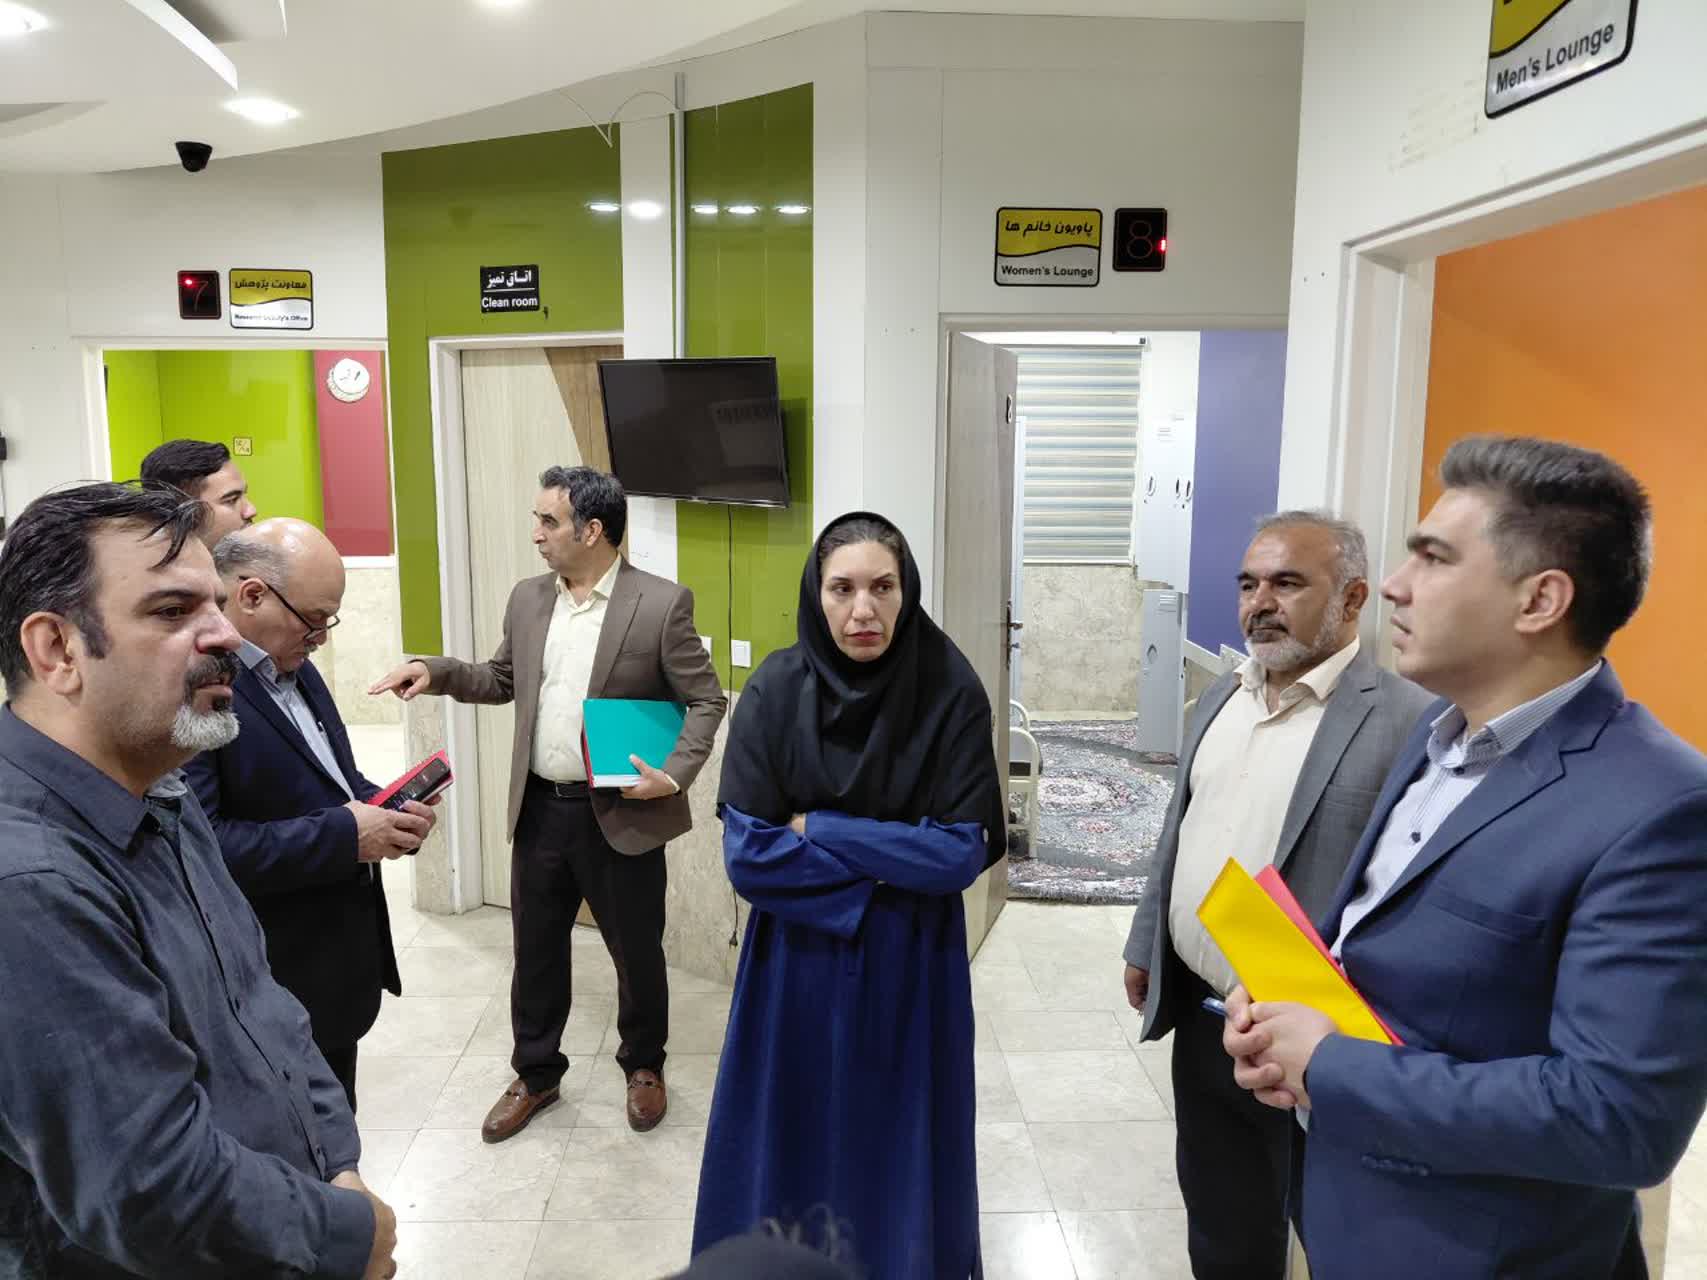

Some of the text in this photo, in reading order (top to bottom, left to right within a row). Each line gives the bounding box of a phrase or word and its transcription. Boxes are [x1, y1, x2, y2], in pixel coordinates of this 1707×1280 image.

[1496, 23, 1615, 94] Men's Lounge
[1005, 220, 1094, 238] پاویون خانم ها
[1126, 219, 1154, 260] 8
[486, 269, 532, 289] اتاق تمیز
[1001, 265, 1094, 278] Women's Lounge
[234, 278, 307, 291] معاونت پژوهش
[481, 296, 538, 308] Clean room
